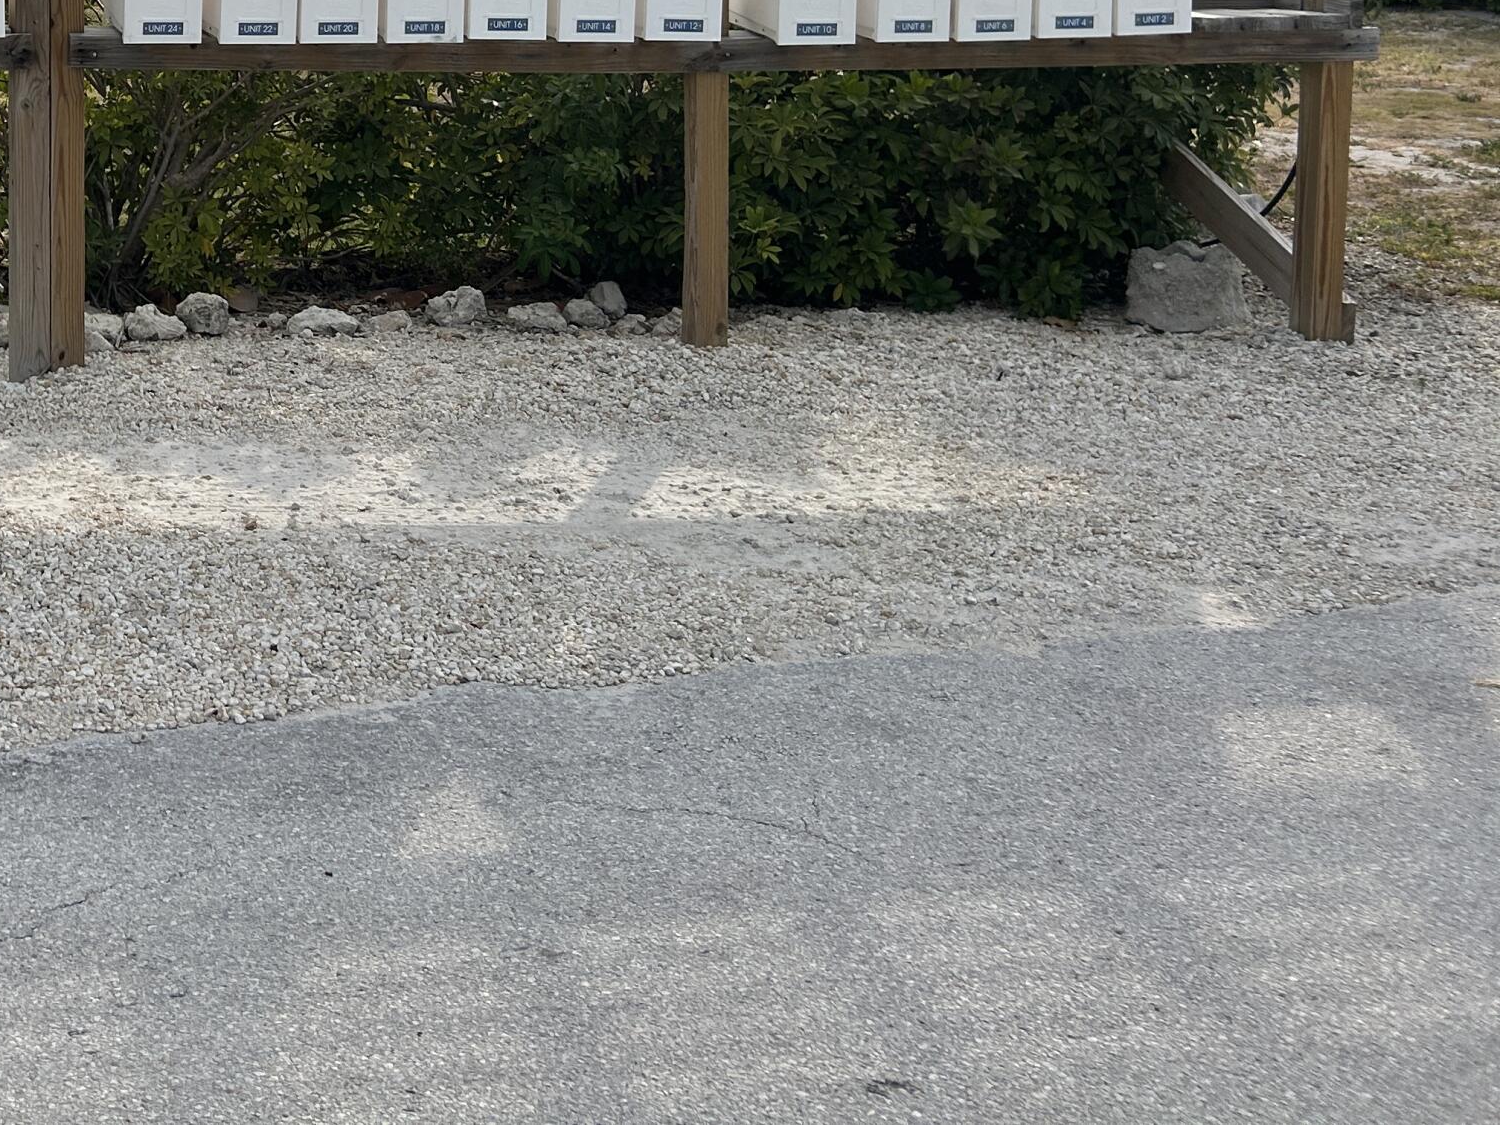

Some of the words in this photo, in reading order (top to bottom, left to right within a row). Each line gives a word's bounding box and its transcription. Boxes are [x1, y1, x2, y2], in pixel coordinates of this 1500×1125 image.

[1062, 18, 1080, 26] UNIT
[1081, 18, 1087, 26] 4
[1142, 15, 1160, 24] UNIT
[1161, 15, 1167, 23] 2
[148, 24, 167, 32] UNIT
[167, 24, 178, 33] 24
[244, 25, 262, 33] UNIT
[263, 24, 273, 33] 22
[323, 24, 342, 33] UNIT
[343, 24, 354, 33] 20
[410, 23, 428, 32] UNIT
[431, 23, 440, 32] 18
[493, 20, 511, 29] UNIT
[514, 20, 523, 29] 16
[582, 22, 599, 31] UNIT
[602, 22, 611, 30] 14
[669, 21, 687, 30] UNIT
[689, 21, 699, 30] 12
[902, 22, 919, 31] UNIT
[983, 21, 1001, 30] UNIT
[802, 25, 821, 34] UNIT
[822, 25, 832, 34] 10
